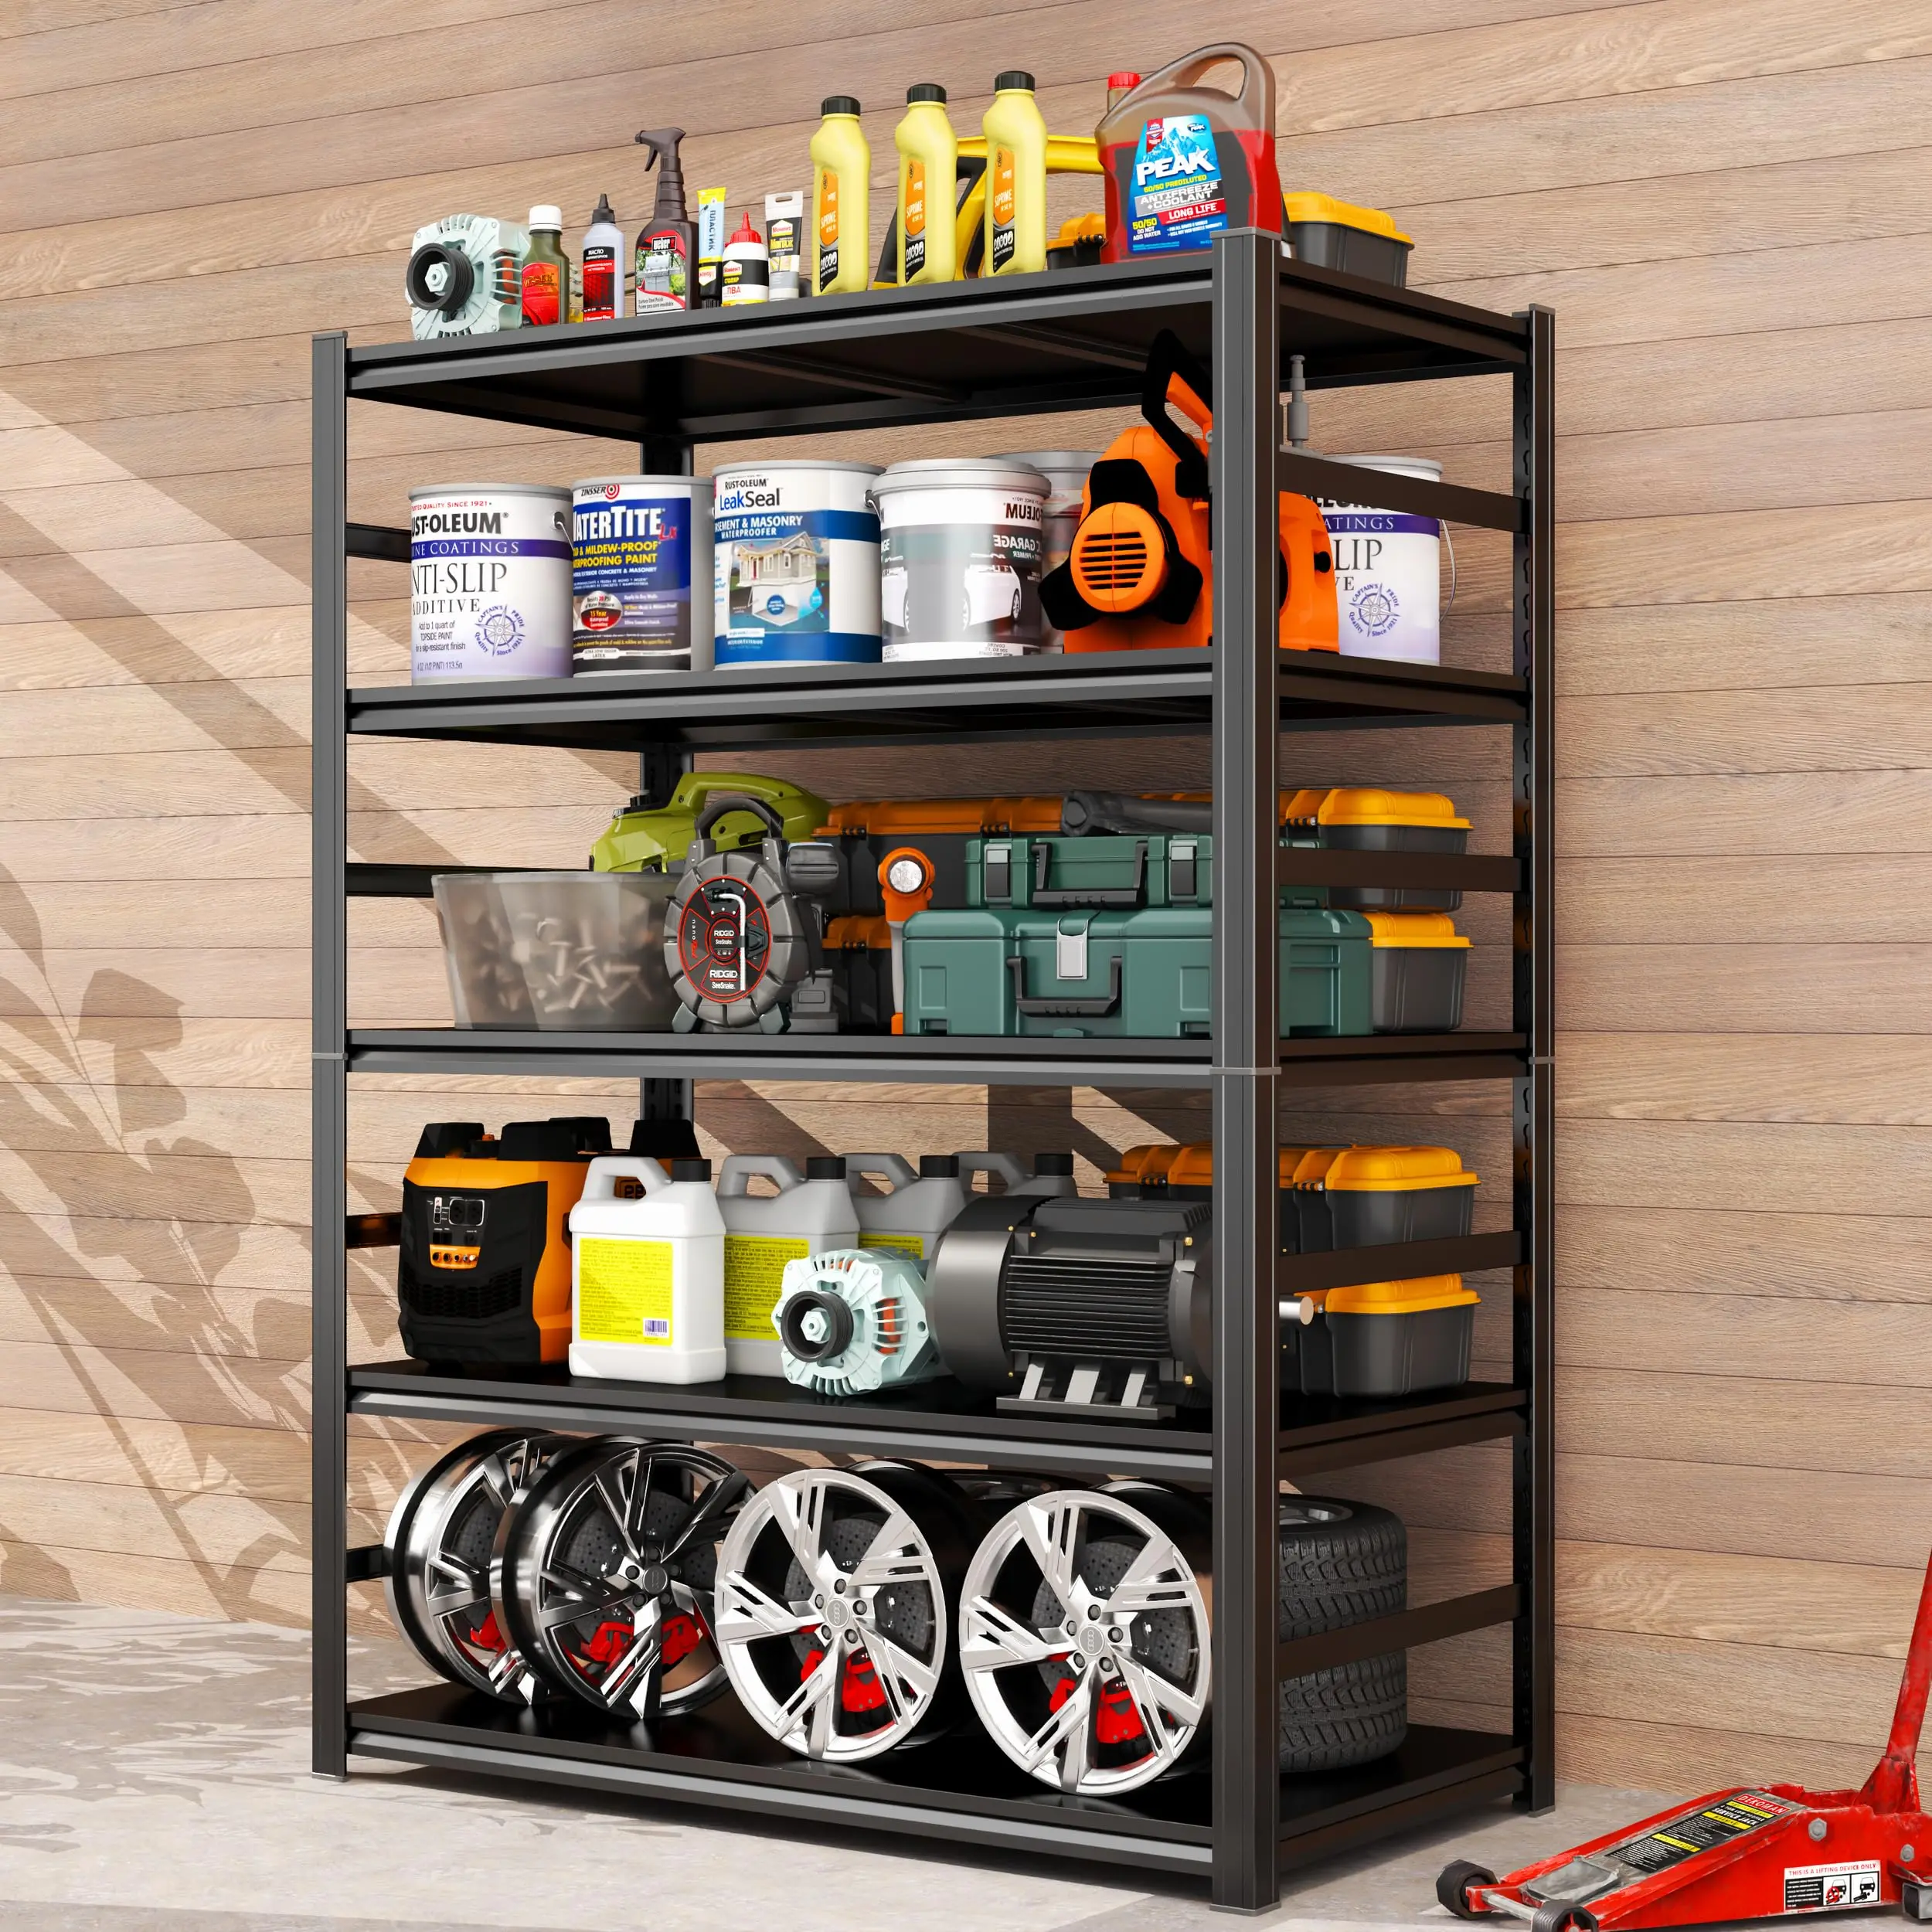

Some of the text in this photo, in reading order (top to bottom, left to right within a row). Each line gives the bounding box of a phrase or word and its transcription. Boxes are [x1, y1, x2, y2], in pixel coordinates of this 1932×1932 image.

[1136, 148, 1216, 186] PEAK
[1141, 182, 1218, 204] ANTIFREEZE
[1168, 208, 1193, 219] LONG
[1196, 202, 1217, 214] LIFE
[1132, 217, 1157, 230] 50/50
[1144, 230, 1161, 239] WATER
[725, 478, 767, 490] RUST-OLEUM
[580, 485, 607, 497] ZINSSER
[719, 488, 780, 511] LeakSeal
[411, 512, 502, 538] UST-OLEUM
[742, 518, 748, 528] &
[750, 515, 803, 528] MASONRY
[1324, 517, 1394, 530] ATINGS
[721, 527, 777, 539] WATERPROOFER
[430, 542, 519, 554] COATINGS
[585, 541, 658, 556] MILDEW-PROOF
[625, 553, 658, 564] PAINT
[411, 563, 508, 597] NTI-SLIP
[435, 621, 448, 631] quart
[449, 620, 455, 628] of
[511, 610, 526, 628] PRIDE
[438, 631, 453, 640] PAINT
[474, 631, 489, 654] Quality
[709, 970, 738, 978] RIDGID
[1737, 1795, 1787, 1814] DEKOMAN
[1712, 1808, 1759, 1826] SERVICE JACK
